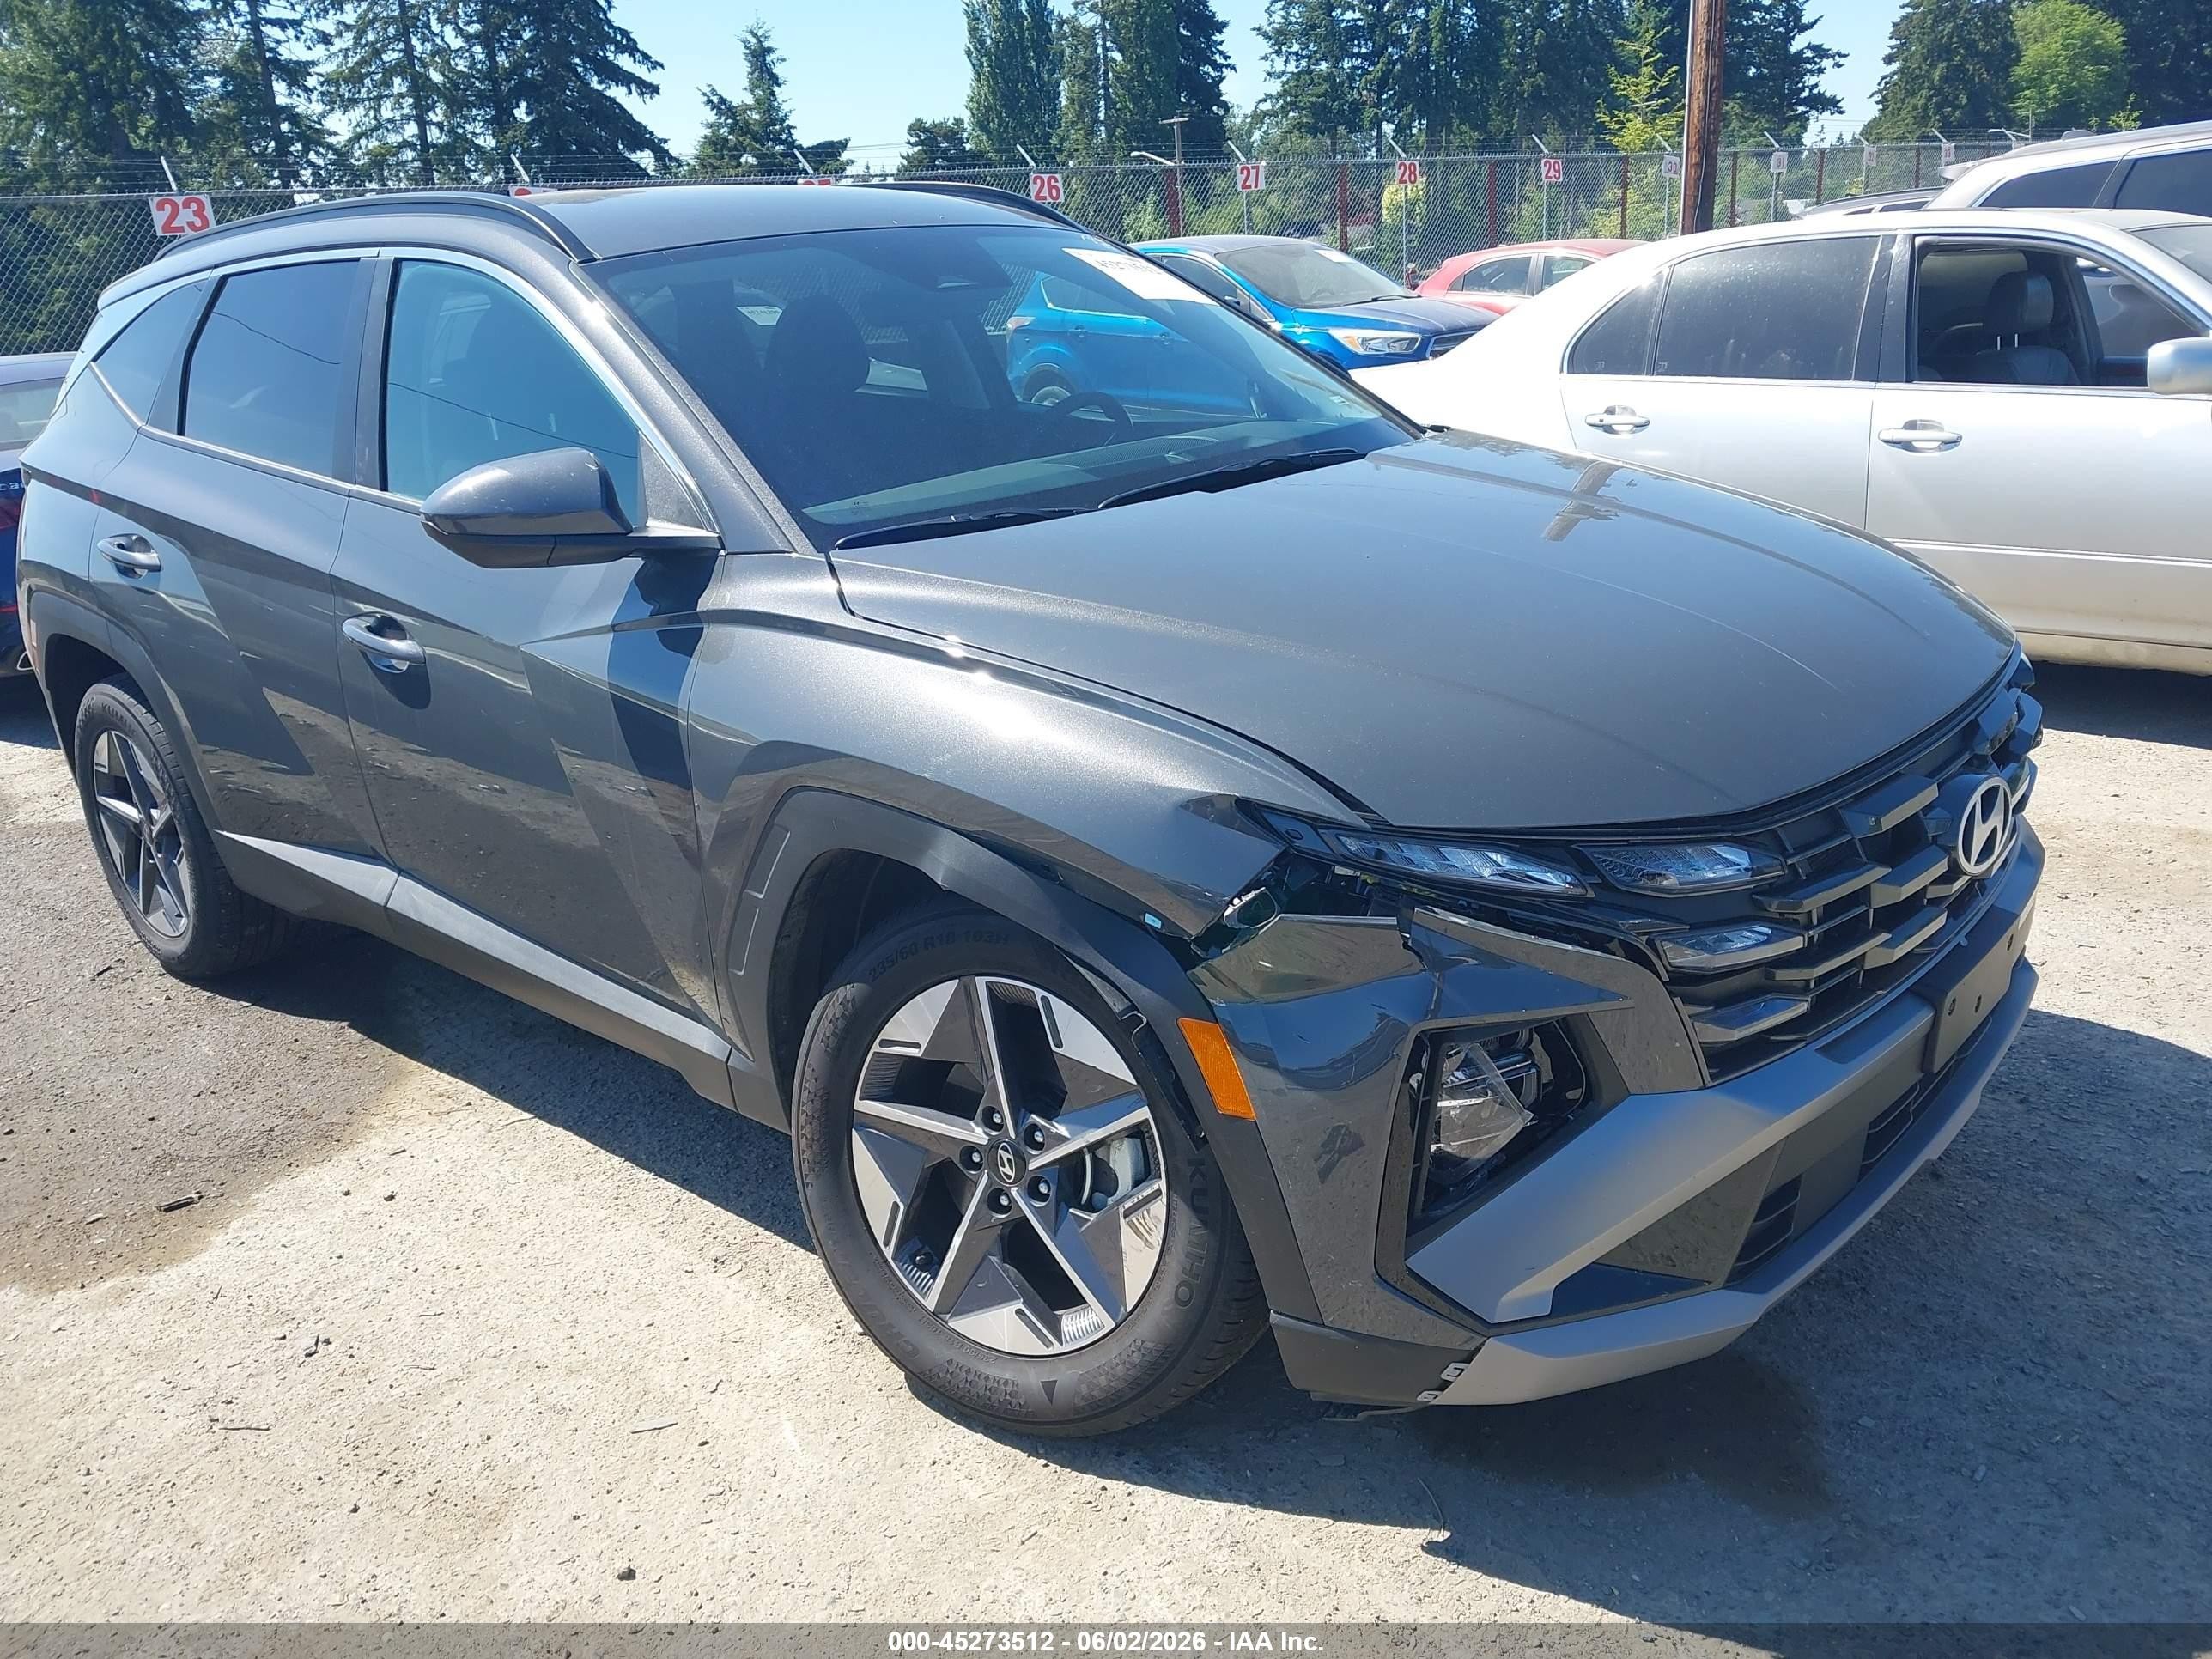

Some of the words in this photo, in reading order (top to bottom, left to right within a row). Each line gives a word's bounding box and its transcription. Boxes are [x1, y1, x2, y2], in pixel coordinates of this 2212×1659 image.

[1240, 165, 1260, 190] 27
[1398, 161, 1417, 185] 28
[1544, 160, 1561, 180] 29
[1032, 175, 1061, 201] 26
[155, 197, 210, 234] 23
[1174, 1159, 1210, 1310] KUMHO
